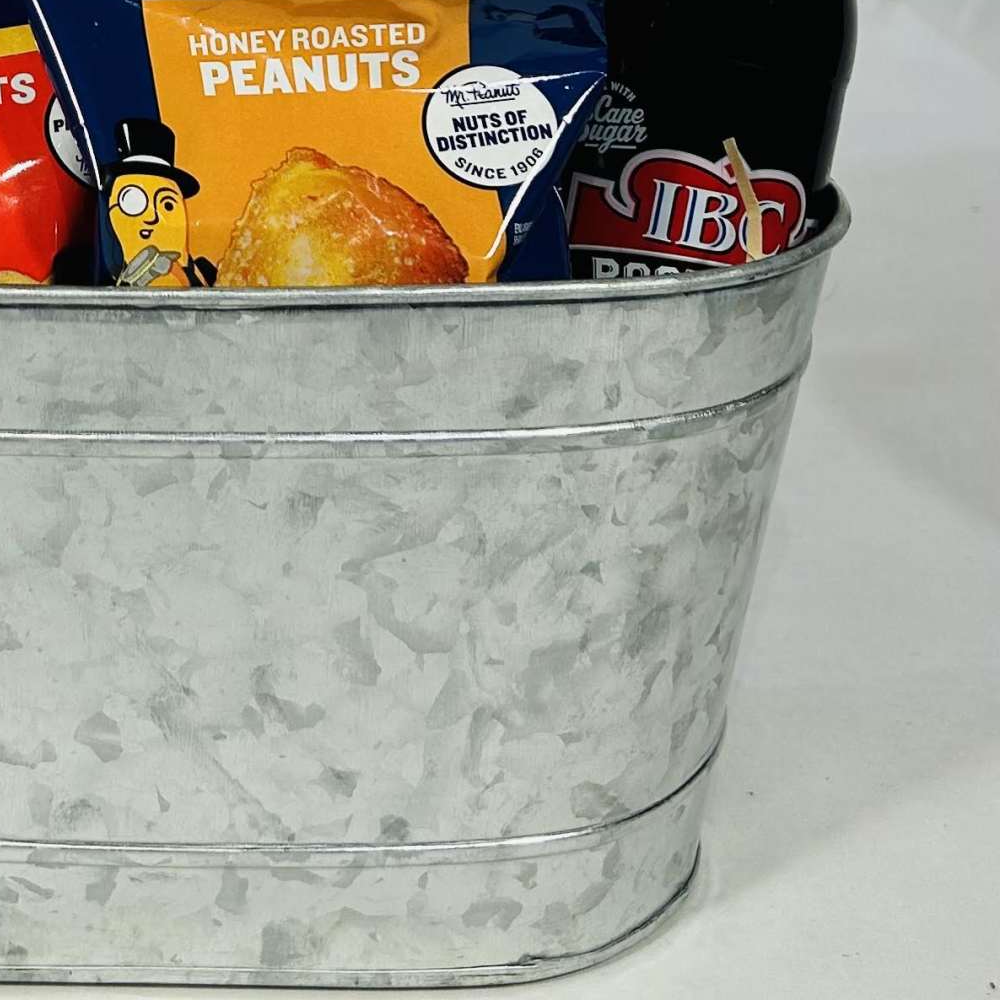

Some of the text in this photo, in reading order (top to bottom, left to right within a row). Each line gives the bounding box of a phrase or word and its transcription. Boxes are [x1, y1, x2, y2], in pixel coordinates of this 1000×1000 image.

[188, 22, 427, 57] HONEY ROASTED
[199, 48, 421, 97] PEANUTS
[611, 81, 637, 102] WITH
[452, 109, 527, 132] NUTS OF
[594, 94, 645, 125] Cane
[436, 123, 553, 152] DISTINCTION
[454, 147, 544, 179] SINCE 1906
[642, 178, 786, 260] IBC
